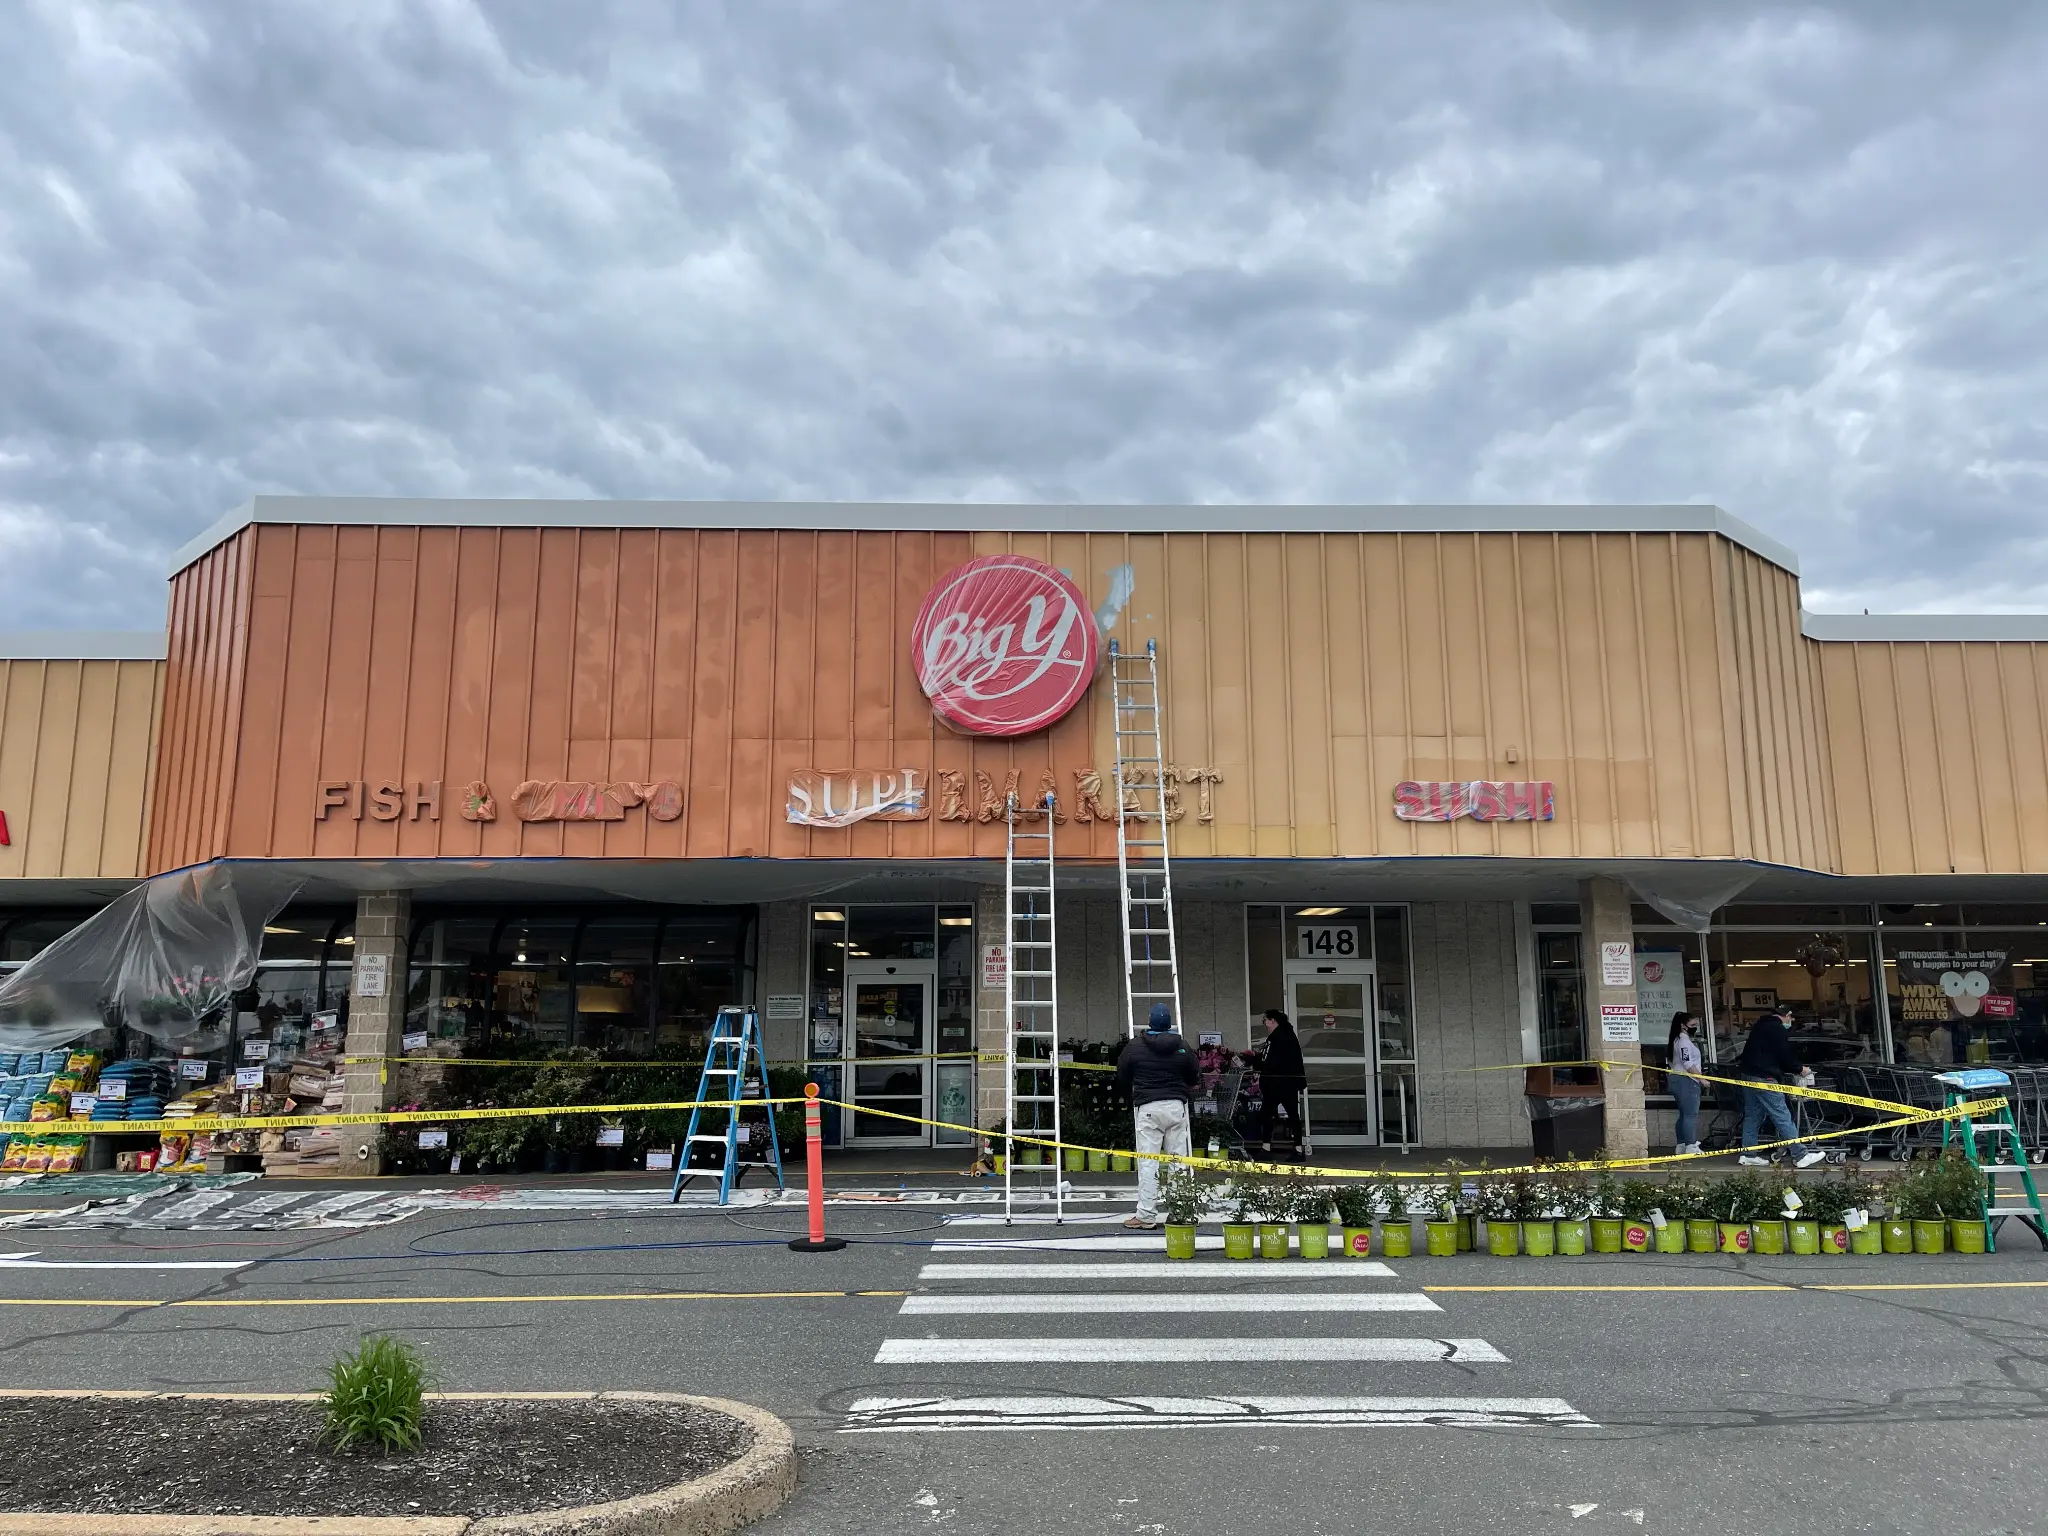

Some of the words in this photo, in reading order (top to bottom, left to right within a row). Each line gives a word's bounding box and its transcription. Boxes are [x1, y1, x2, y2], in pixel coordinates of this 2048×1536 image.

[925, 612, 1016, 687] Big
[315, 779, 444, 821] FISH
[1394, 781, 1554, 822] SUSHI
[1301, 929, 1355, 955] 148
[992, 948, 1002, 956] NO
[1969, 951, 1986, 959] best
[1987, 951, 2006, 960] thing
[360, 965, 384, 973] PARKING
[1913, 960, 1921, 968] to
[1922, 960, 1951, 970] happen
[1952, 960, 1960, 968] to
[1961, 961, 1979, 970] your
[1980, 960, 1996, 969] day!
[1640, 991, 1672, 999] STORE
[1900, 984, 1947, 998] WIDE
[1640, 1001, 1674, 1010] HOURS
[1903, 998, 1948, 1011] AWAKE
[1903, 1012, 1935, 1020] COFFEE
[1937, 1012, 1949, 1020] CO
[1977, 1098, 2006, 1109] PAINT
